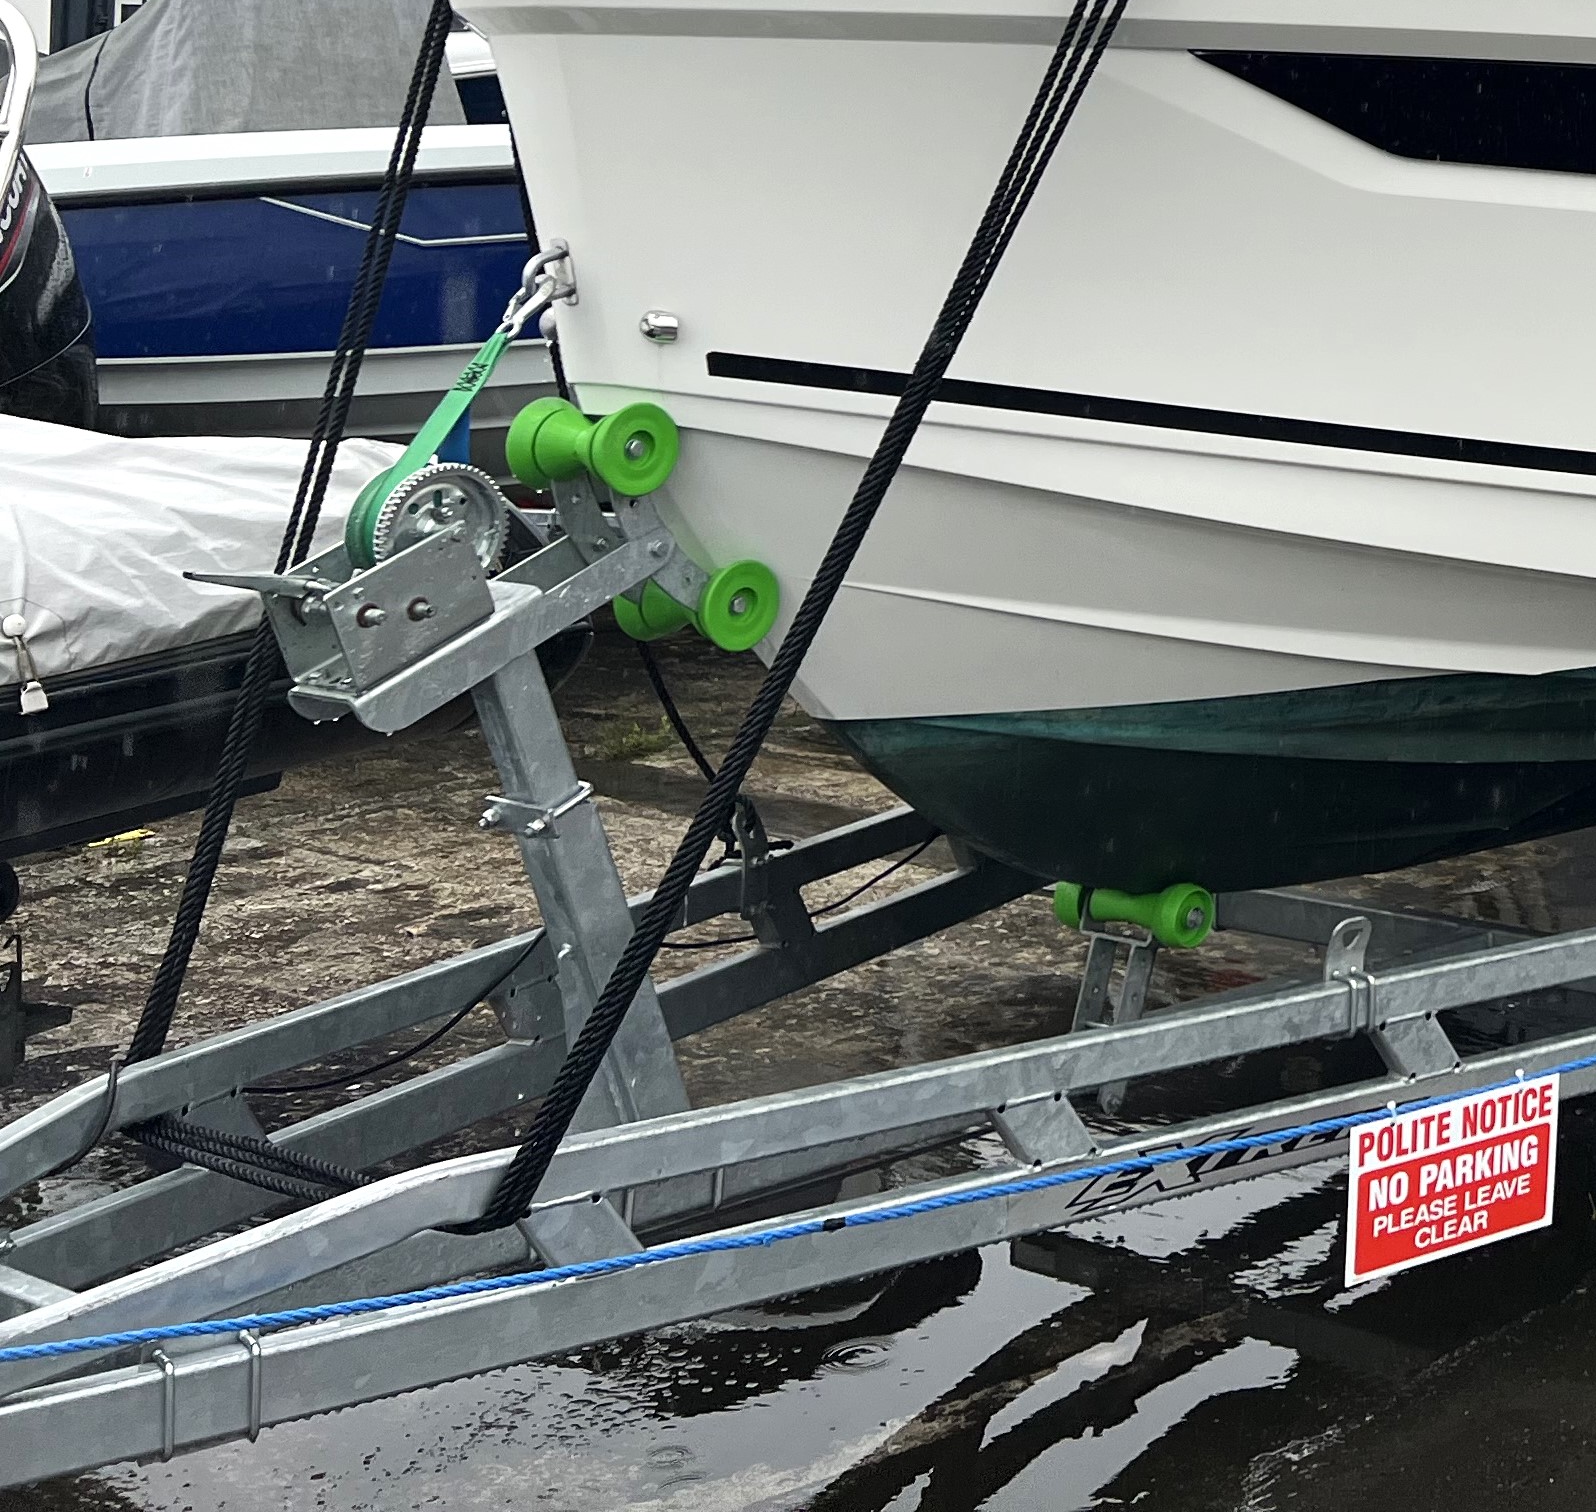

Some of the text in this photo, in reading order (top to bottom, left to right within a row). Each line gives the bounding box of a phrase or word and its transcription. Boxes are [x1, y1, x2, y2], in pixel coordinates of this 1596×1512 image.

[1358, 1083, 1553, 1167] POLITE NOTICE
[1368, 1134, 1539, 1212] NO PARKING
[1373, 1173, 1531, 1237] PLEASE LEAVE
[1414, 1211, 1489, 1249] CLEAR
